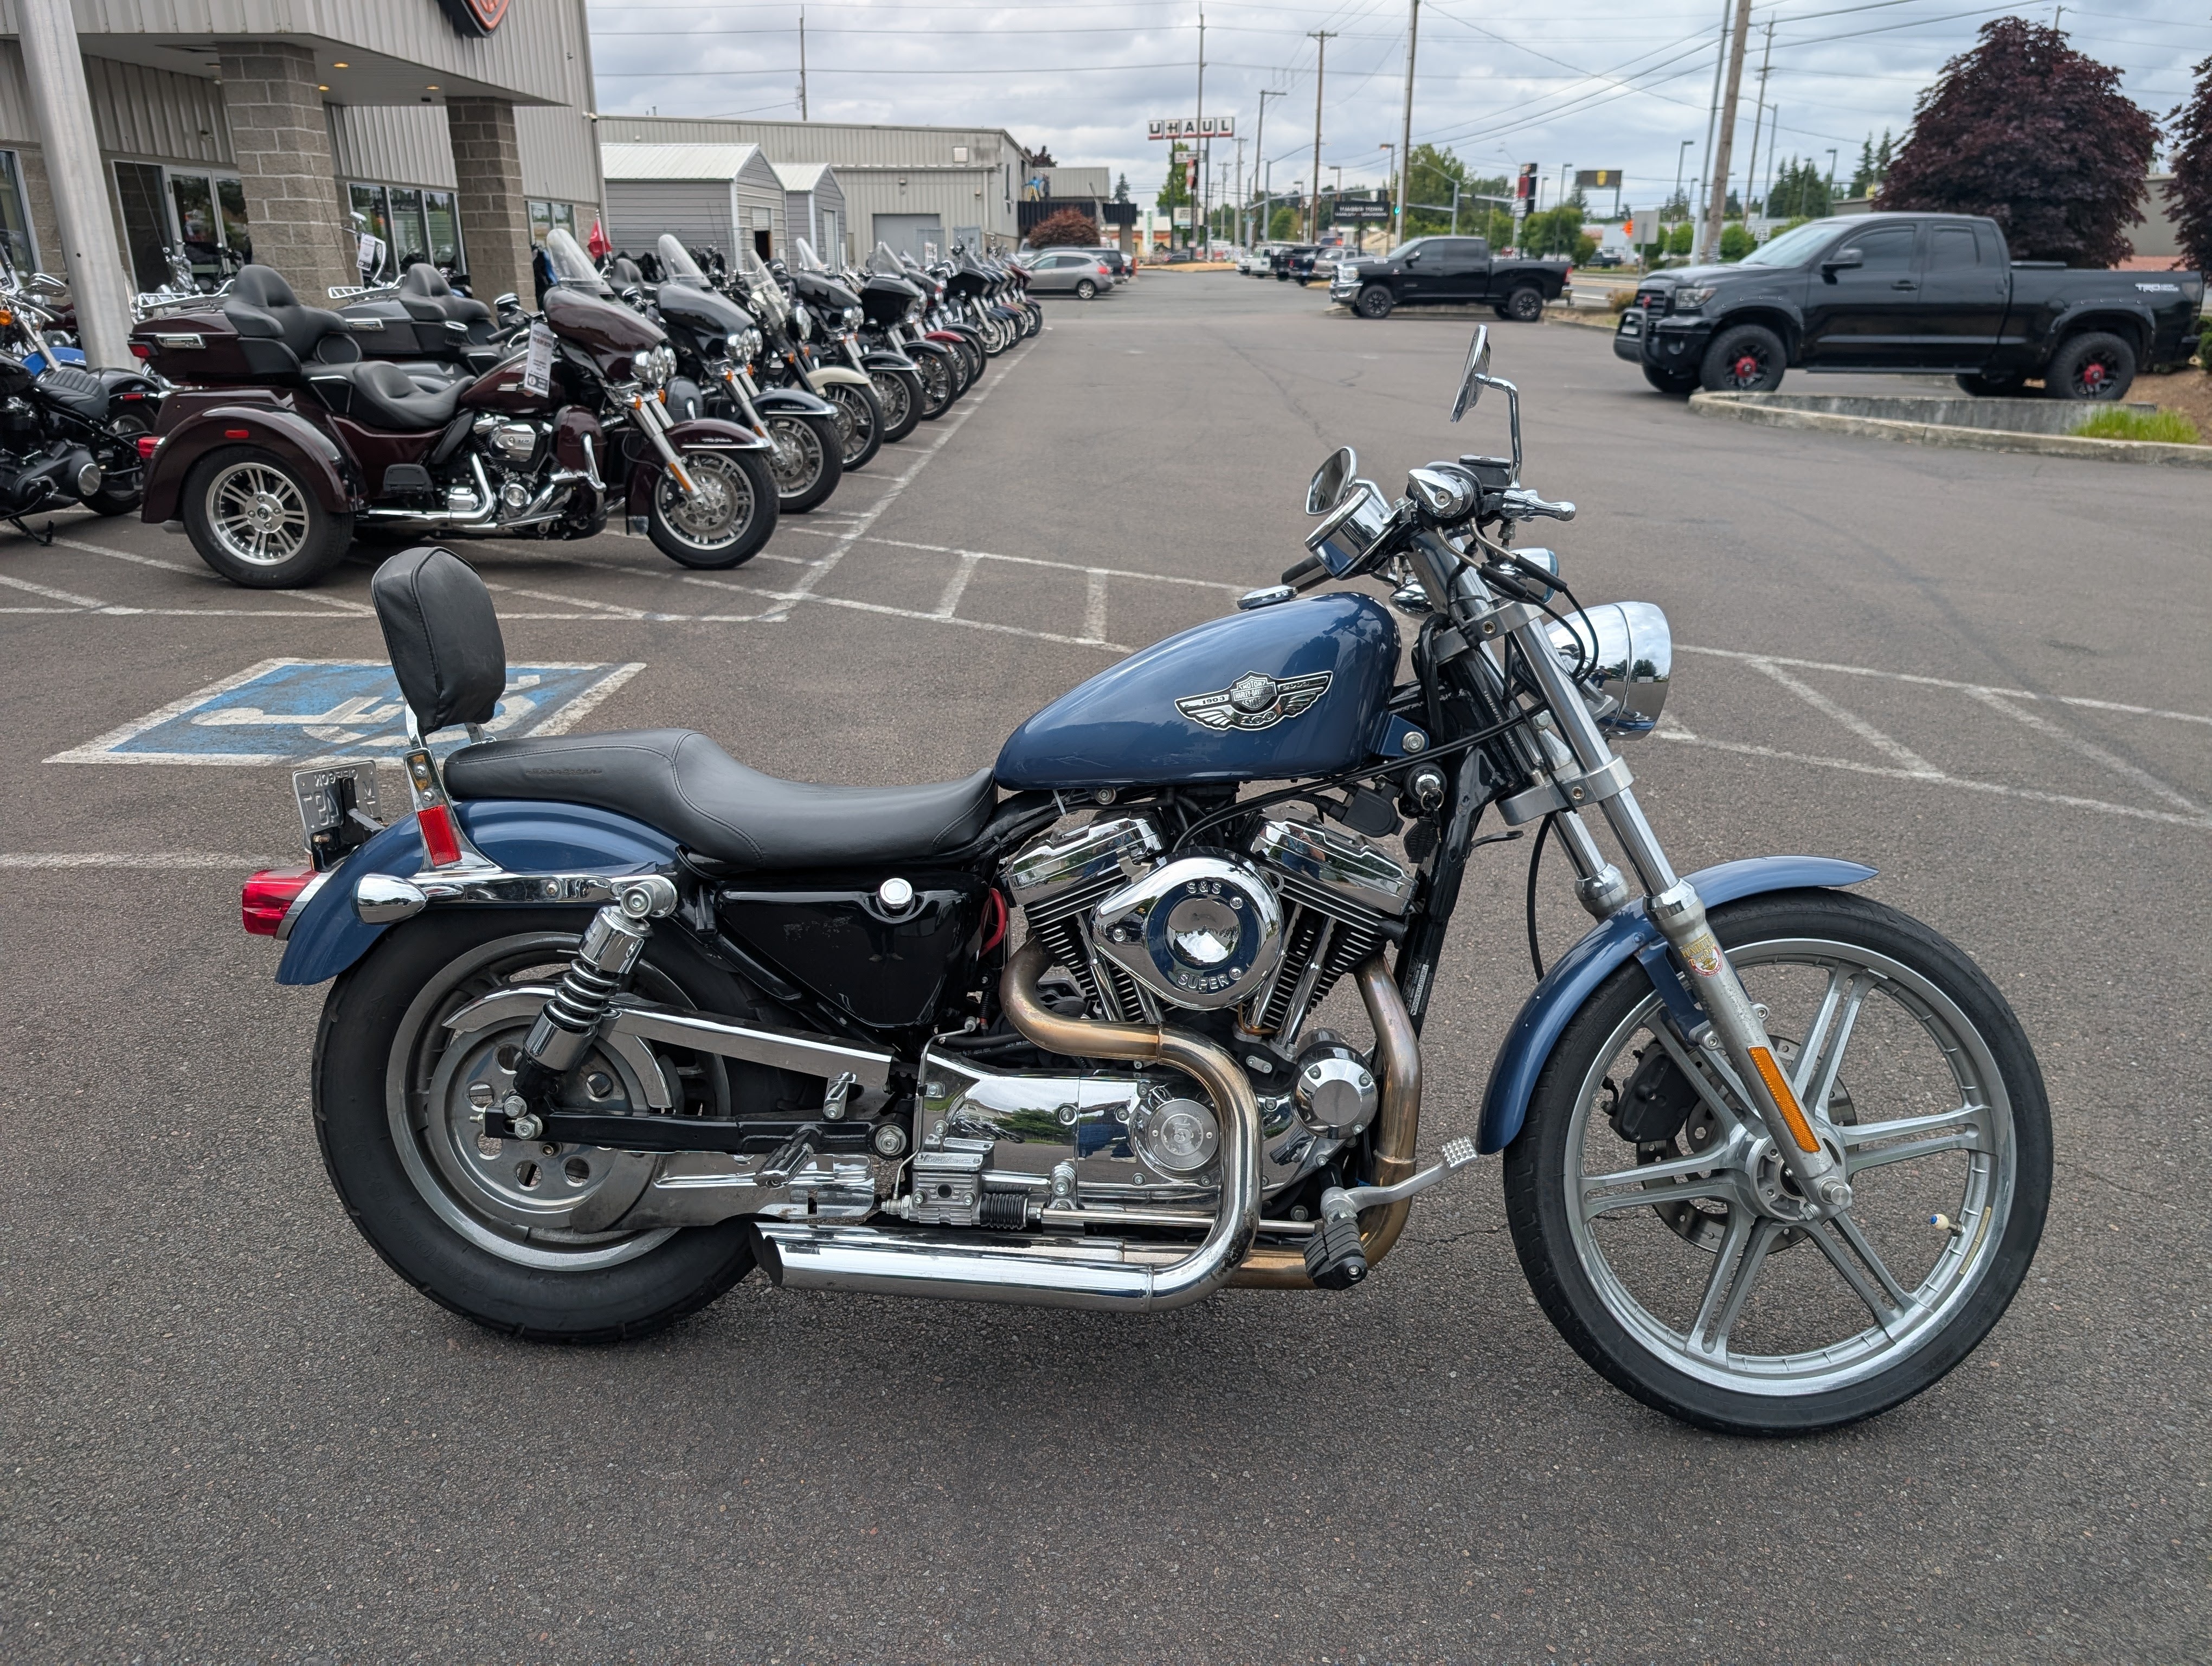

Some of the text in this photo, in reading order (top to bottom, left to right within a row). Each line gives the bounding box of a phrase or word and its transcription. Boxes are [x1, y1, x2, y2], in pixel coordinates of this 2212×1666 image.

[1242, 680, 1263, 690] MOTOR
[1202, 695, 1226, 704] 1903
[1186, 880, 1221, 894] S&S
[1177, 971, 1230, 990] SUPER
